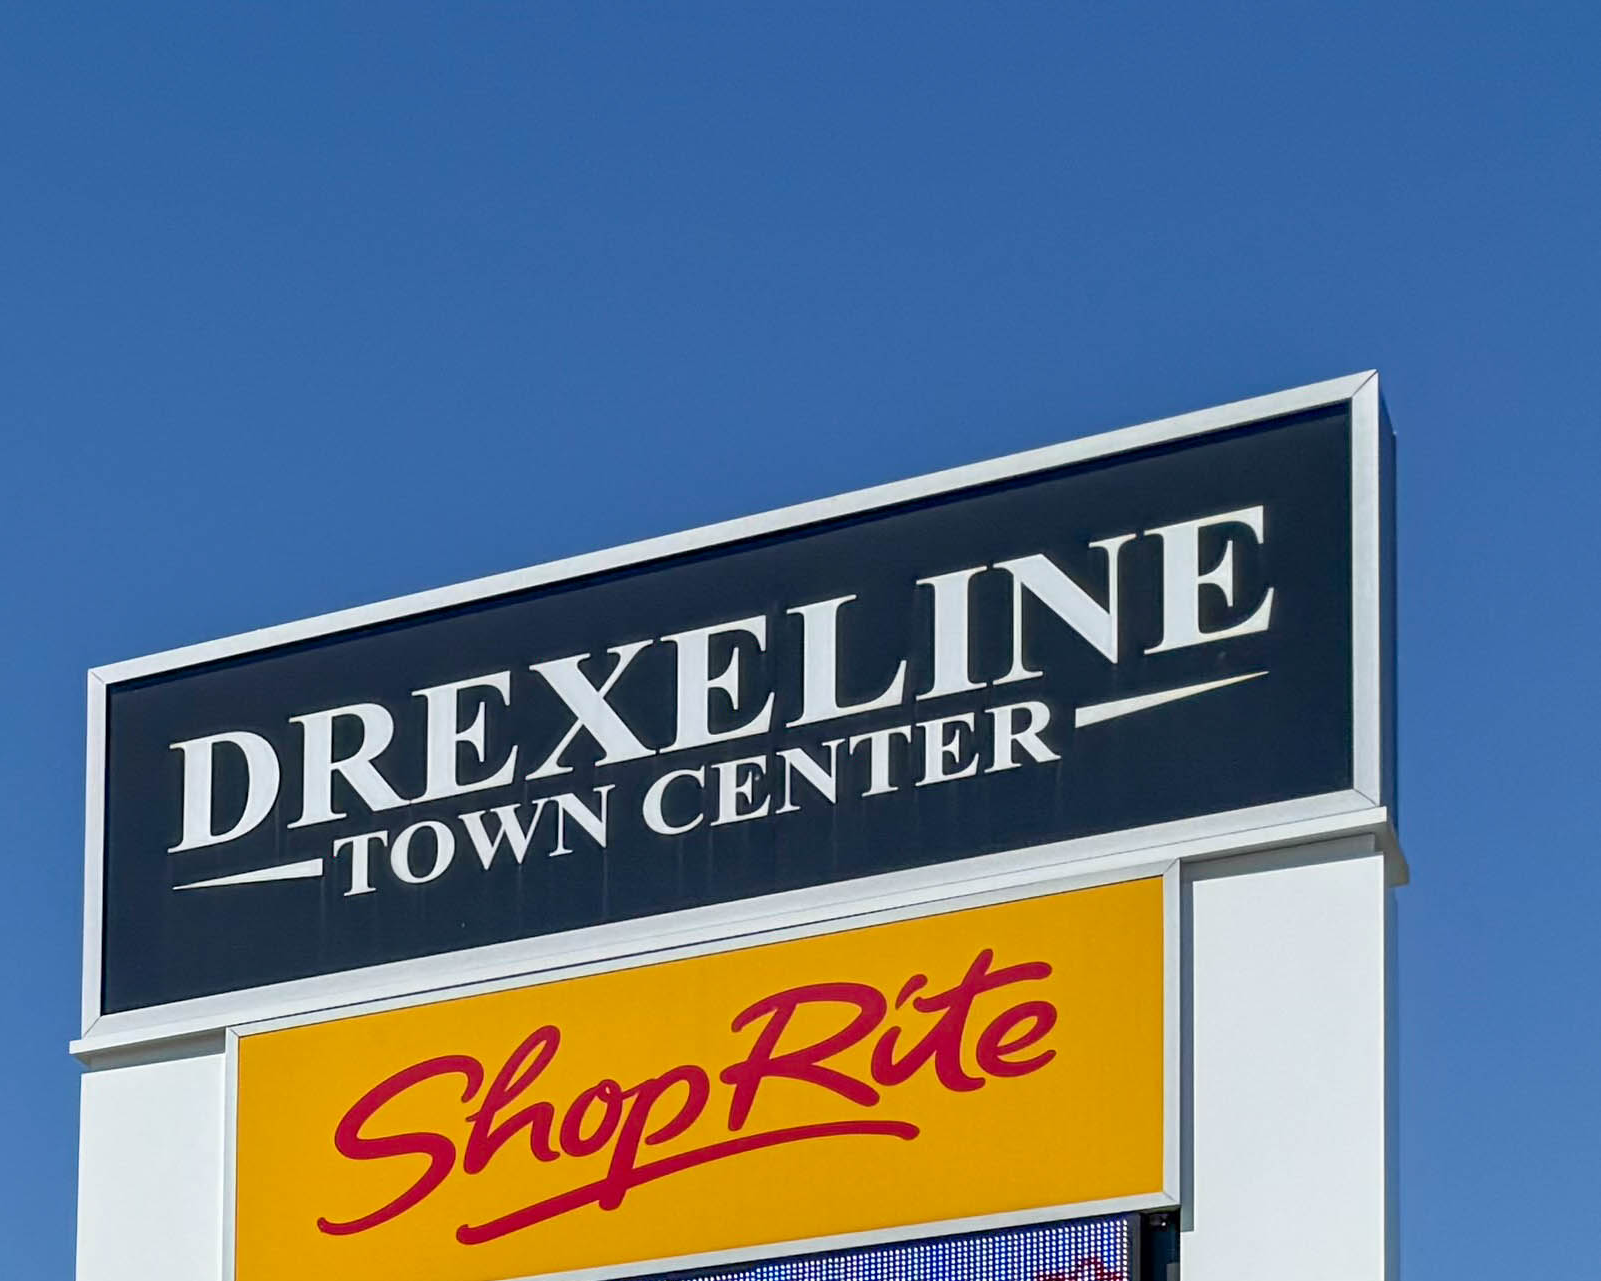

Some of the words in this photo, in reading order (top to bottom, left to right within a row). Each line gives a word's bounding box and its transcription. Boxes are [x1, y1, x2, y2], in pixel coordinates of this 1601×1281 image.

[167, 505, 1274, 853] DREXELINE
[332, 784, 616, 897] TOWN
[642, 701, 1061, 835] CENTER
[317, 949, 1057, 1242] ShopRite
